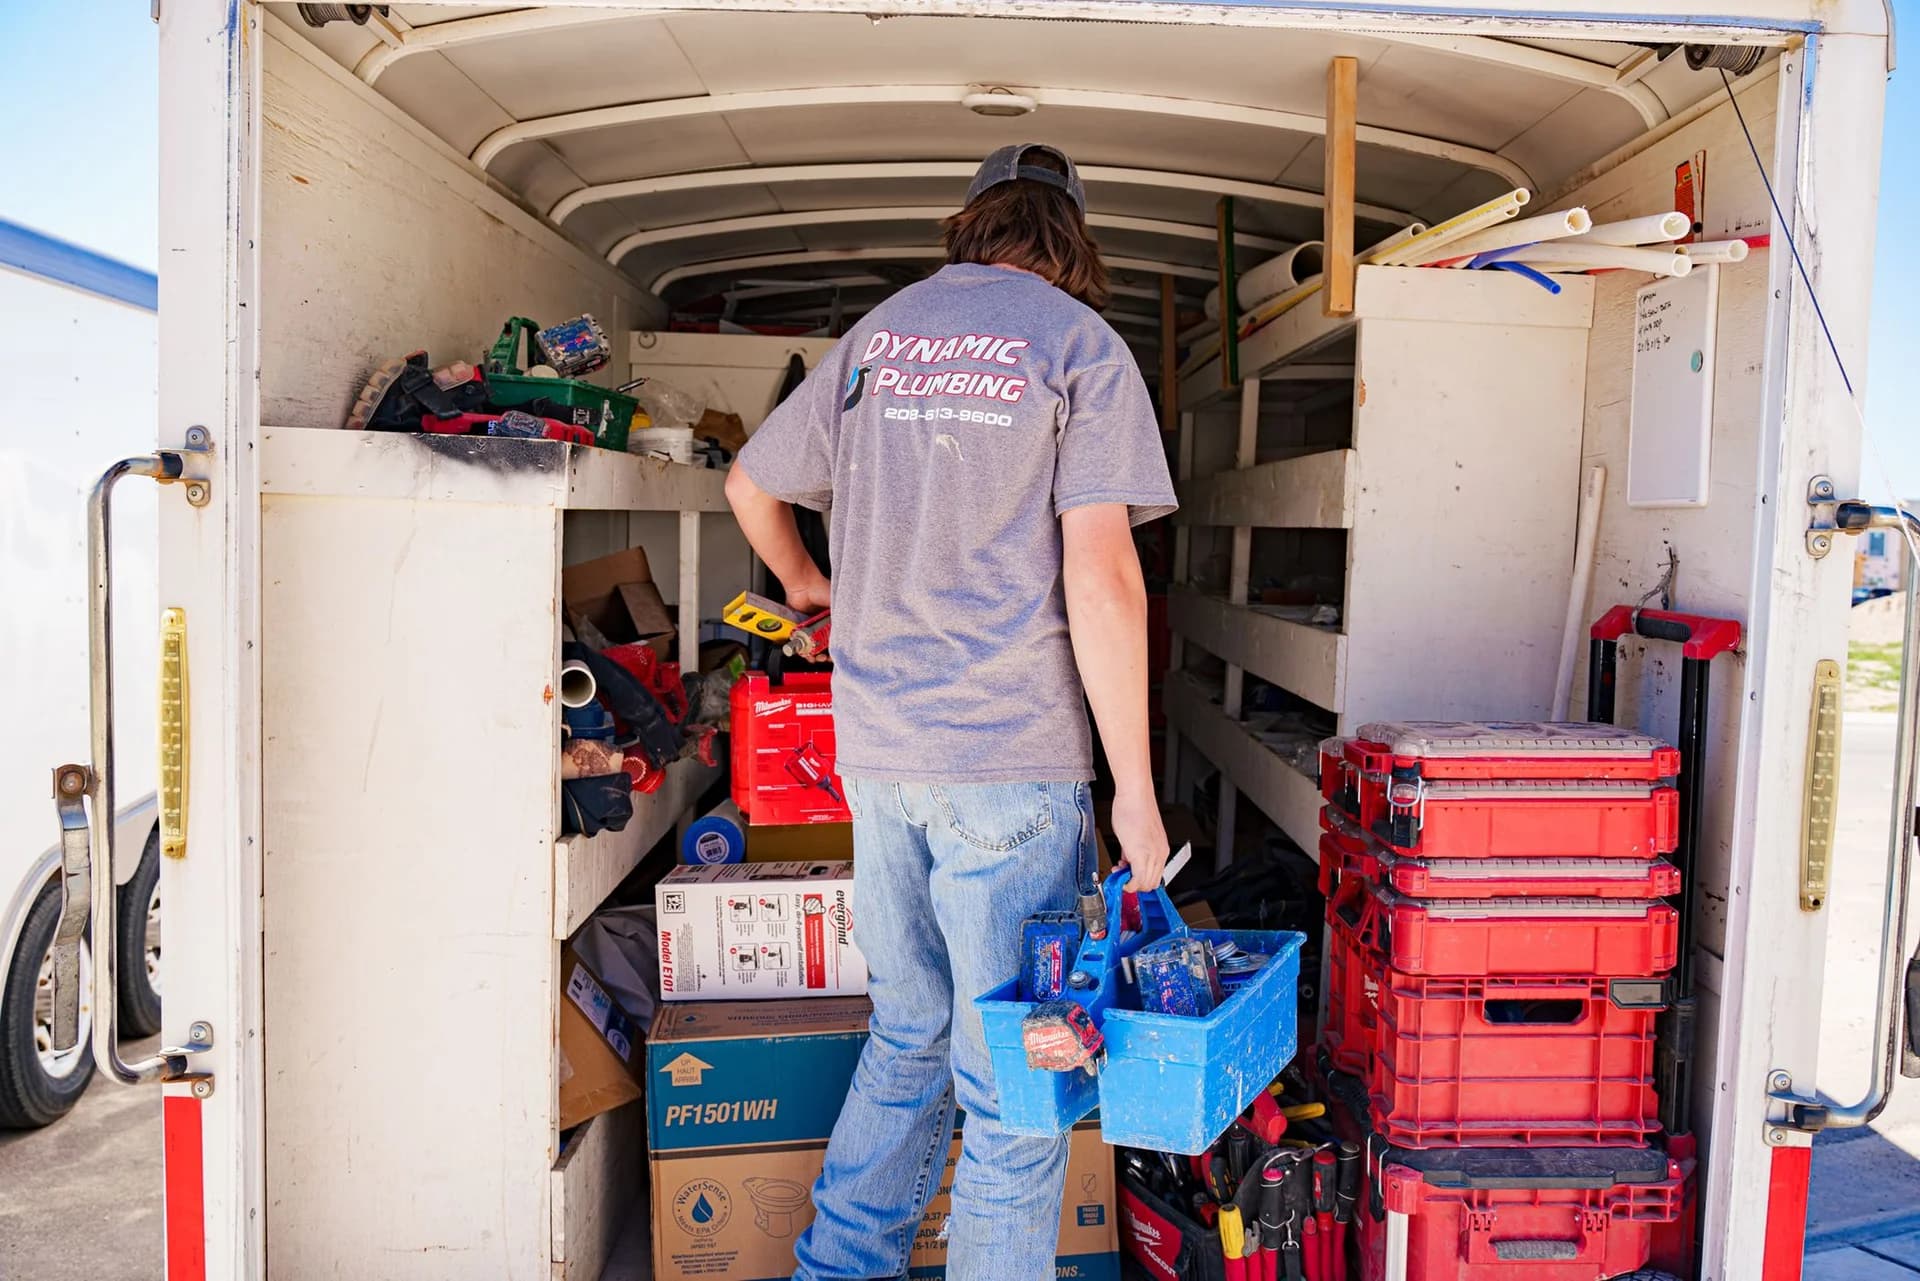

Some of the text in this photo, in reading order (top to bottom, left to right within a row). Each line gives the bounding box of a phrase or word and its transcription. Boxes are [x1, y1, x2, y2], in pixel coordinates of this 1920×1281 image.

[861, 330, 1031, 367] DYNAMIC
[872, 367, 1027, 404] PLUMBING
[834, 889, 849, 946] evergrind
[661, 930, 674, 993] Model E101
[665, 1099, 778, 1127] PF1501WH
[677, 1181, 727, 1205] WaterSense
